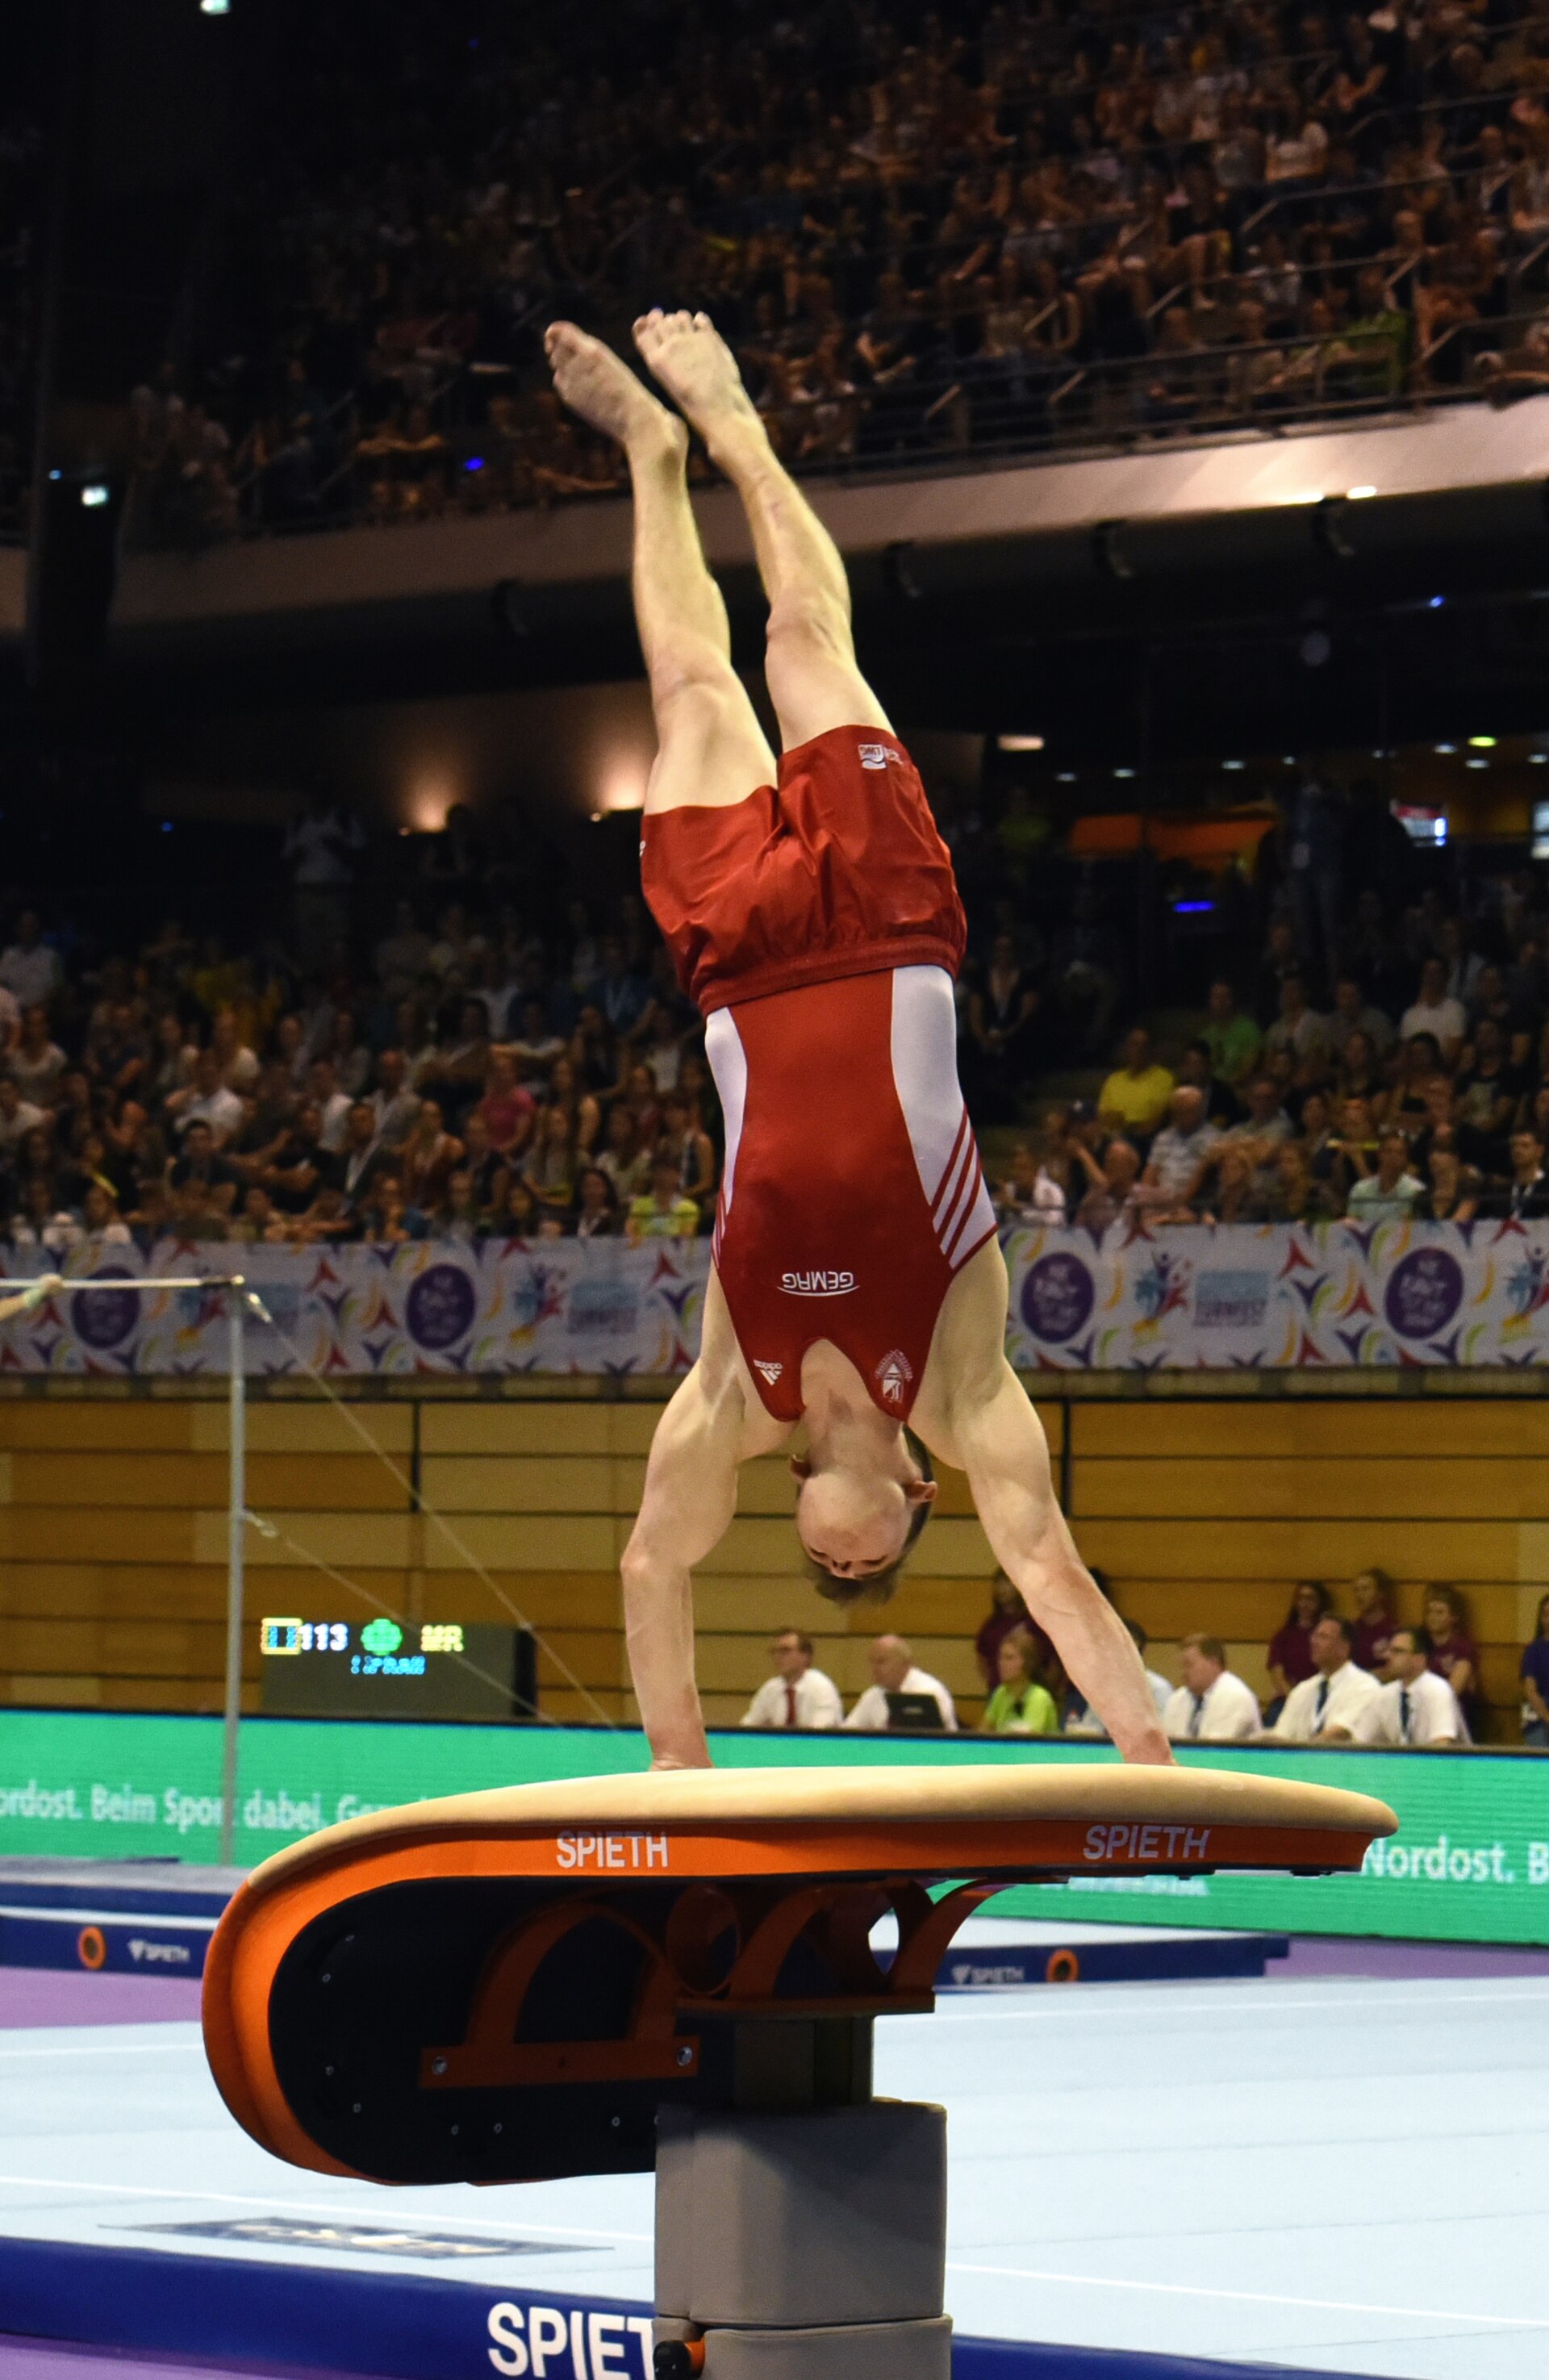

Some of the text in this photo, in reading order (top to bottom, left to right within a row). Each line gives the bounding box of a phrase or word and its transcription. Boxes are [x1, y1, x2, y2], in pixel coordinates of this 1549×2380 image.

[782, 1271, 854, 1291] GEMAG
[90, 1782, 157, 1823] Beim
[163, 1786, 234, 1835] Spor
[556, 1831, 667, 1869] SPIETH
[1083, 1824, 1212, 1862] SPIETH
[1360, 1835, 1515, 1884] Nordost.
[487, 2302, 654, 2380] SPIET
